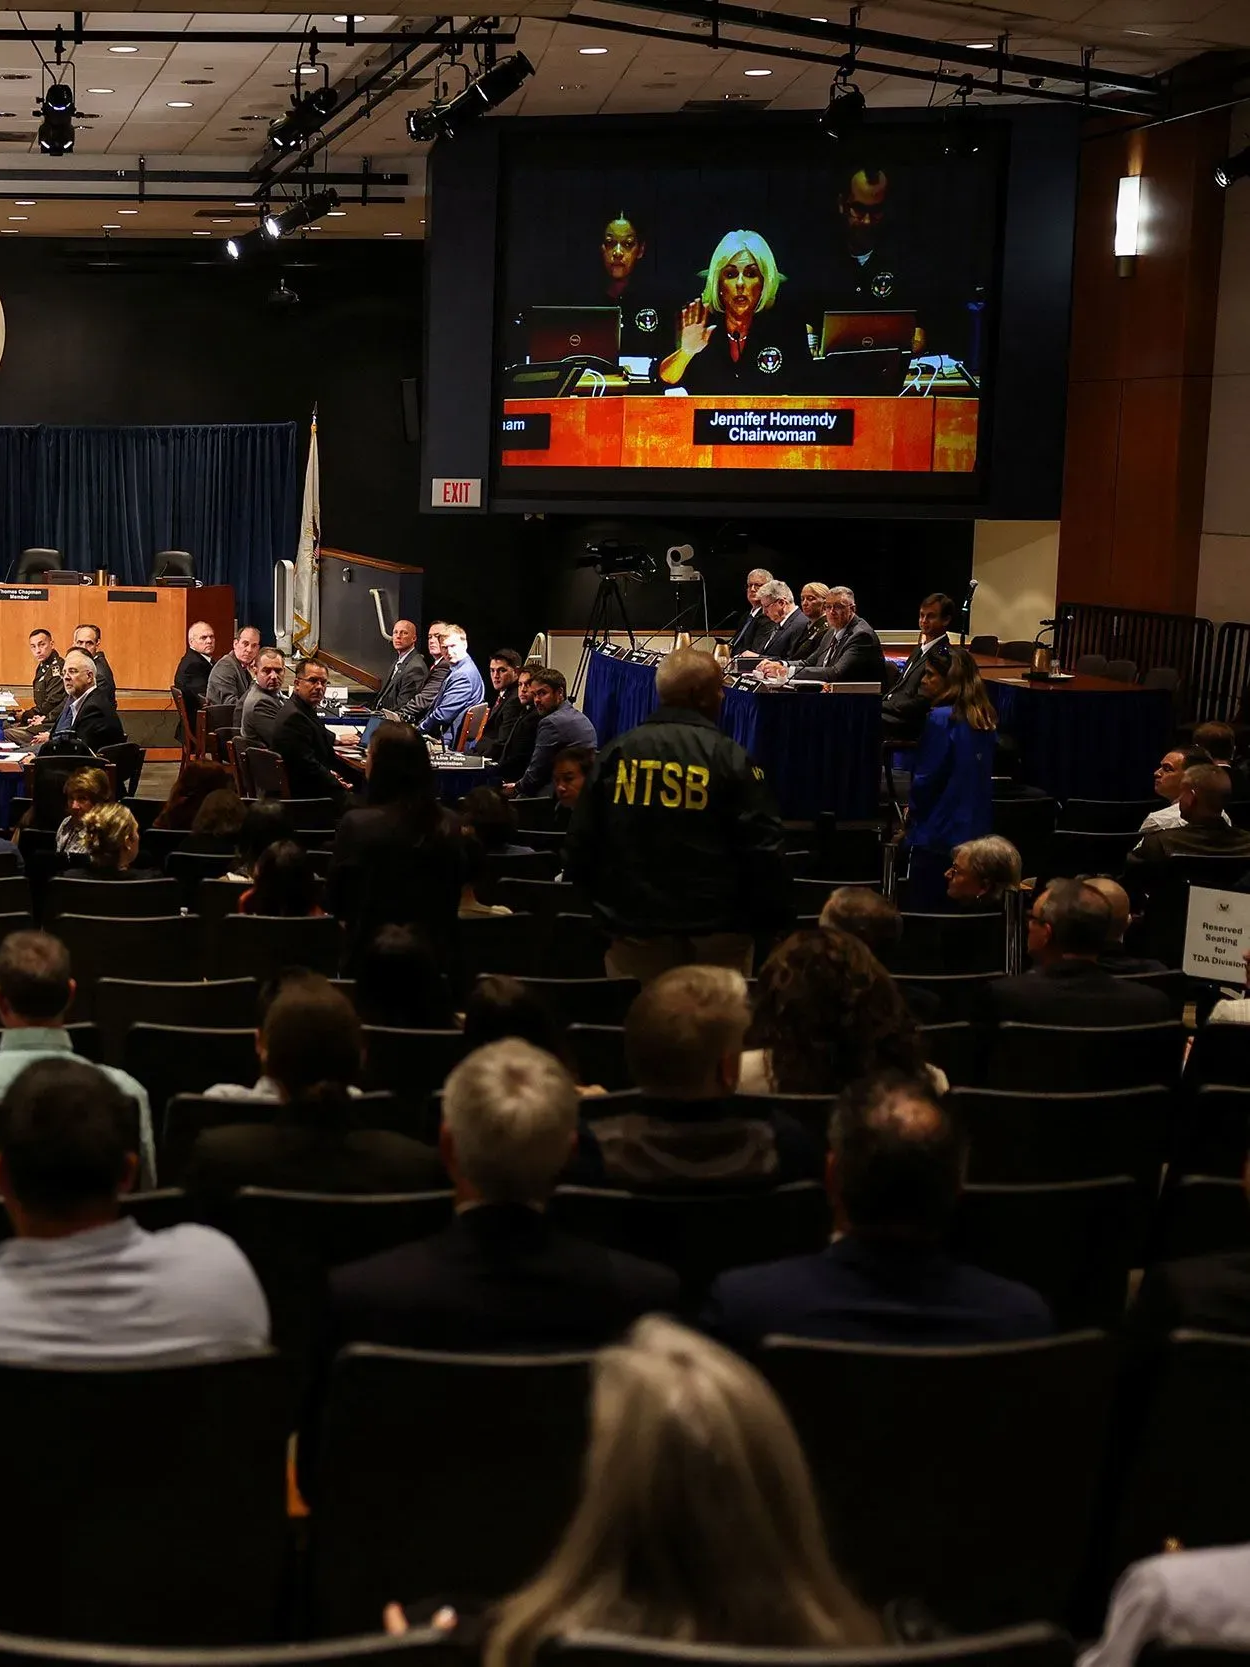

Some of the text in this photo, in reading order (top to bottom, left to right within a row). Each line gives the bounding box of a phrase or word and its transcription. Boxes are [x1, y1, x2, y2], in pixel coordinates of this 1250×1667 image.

[710, 412, 837, 429] Jennifer Homendy
[729, 427, 816, 441] Chairwoman
[443, 482, 470, 503] EXIT
[613, 758, 710, 810] NTSB
[1203, 922, 1243, 935] Reserved
[1205, 934, 1238, 947] Seating
[1214, 946, 1226, 955] for
[1192, 953, 1210, 964] TDA
